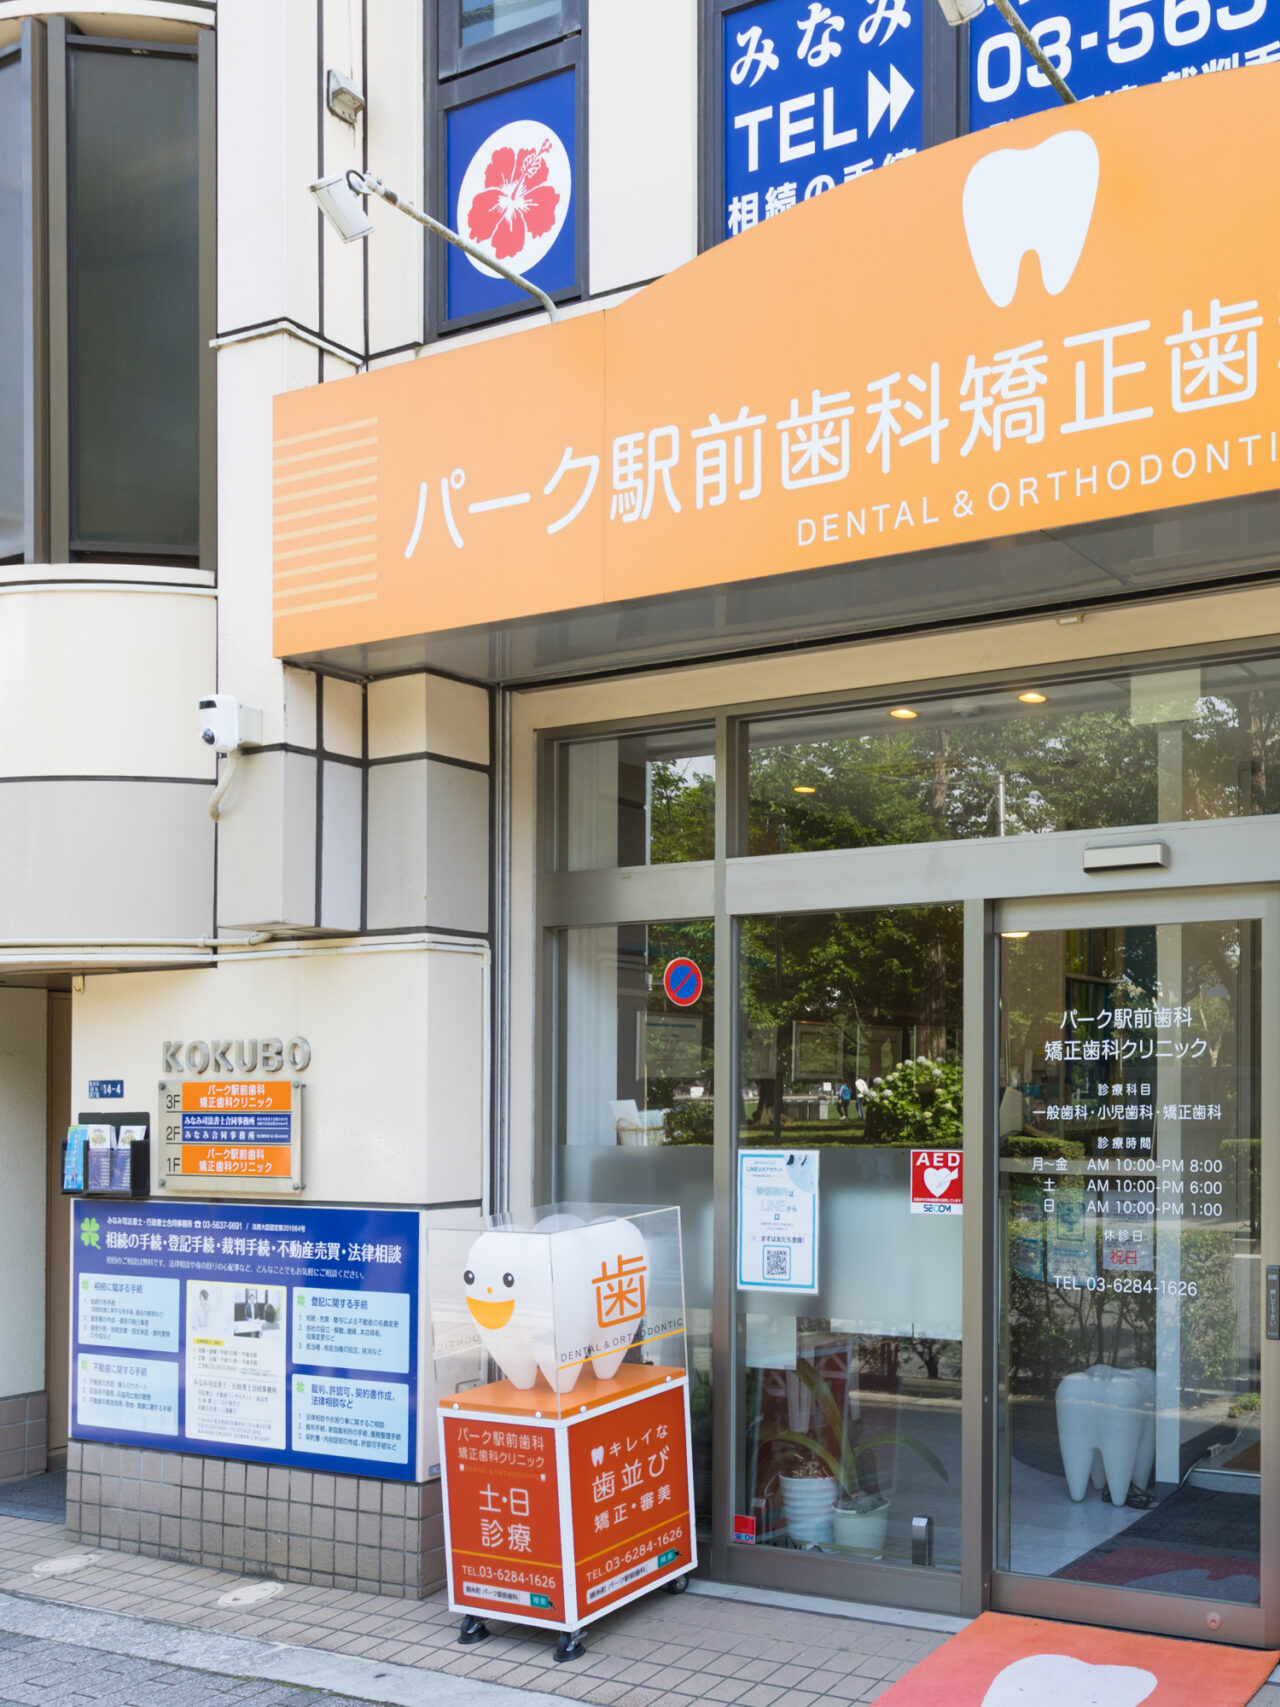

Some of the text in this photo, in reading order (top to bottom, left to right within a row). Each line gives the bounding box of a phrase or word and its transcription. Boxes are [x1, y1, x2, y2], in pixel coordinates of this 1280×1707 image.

[734, 86, 858, 172] TEL
[798, 497, 939, 546] DENTAL
[953, 489, 975, 516] &
[1060, 1005, 1193, 1030] パーク駅前歯科
[162, 1036, 311, 1073] KOKUBO
[1044, 1038, 1208, 1061] 矯正歯科クリニック
[103, 1084, 121, 1095] 14-4
[207, 1084, 265, 1096] パーク駅前歯科
[1097, 1083, 1151, 1096] 診療科目
[166, 1094, 181, 1109] 3F
[199, 1096, 273, 1109] 矯正歯科クリニック
[1032, 1104, 1222, 1121] 一般歯科・小児歯科・矯正歯科
[166, 1127, 181, 1141] 2F
[1097, 1136, 1151, 1150] 診療時間
[207, 1148, 265, 1161] パーク駅前歯科
[915, 1153, 960, 1167] AED
[166, 1157, 181, 1172] 1F
[199, 1160, 273, 1173] 矯正歯科クリニック
[1087, 1158, 1109, 1171] AM
[1189, 1159, 1223, 1174] 8:00
[1043, 1178, 1056, 1192] 土
[1087, 1179, 1109, 1193] AM
[1189, 1180, 1223, 1195] 6:00
[923, 1204, 952, 1213] SECOM
[1044, 1198, 1055, 1213] 日
[1087, 1200, 1109, 1214] AM
[1191, 1202, 1223, 1217] 1:00
[1103, 1228, 1143, 1243] 休診日
[1109, 1250, 1137, 1266] 祝日
[592, 1254, 647, 1328] 歯
[1053, 1276, 1198, 1297] TEL 03-6284-1626
[311, 1296, 369, 1310] 登記に関する手続
[560, 1345, 602, 1363] DENTAL
[612, 1318, 683, 1347] ORTHODONTIC
[311, 1396, 353, 1409] 法律相談など
[457, 1427, 544, 1452] パーク駅前歯科
[608, 1424, 669, 1457] キレイな
[458, 1446, 545, 1468] 矯正歯科クリニック
[592, 1445, 670, 1504] 歯並び
[479, 1483, 530, 1517] 土・日
[480, 1518, 532, 1553] 診療
[462, 1565, 556, 1589] TEL.03-6284-1626
